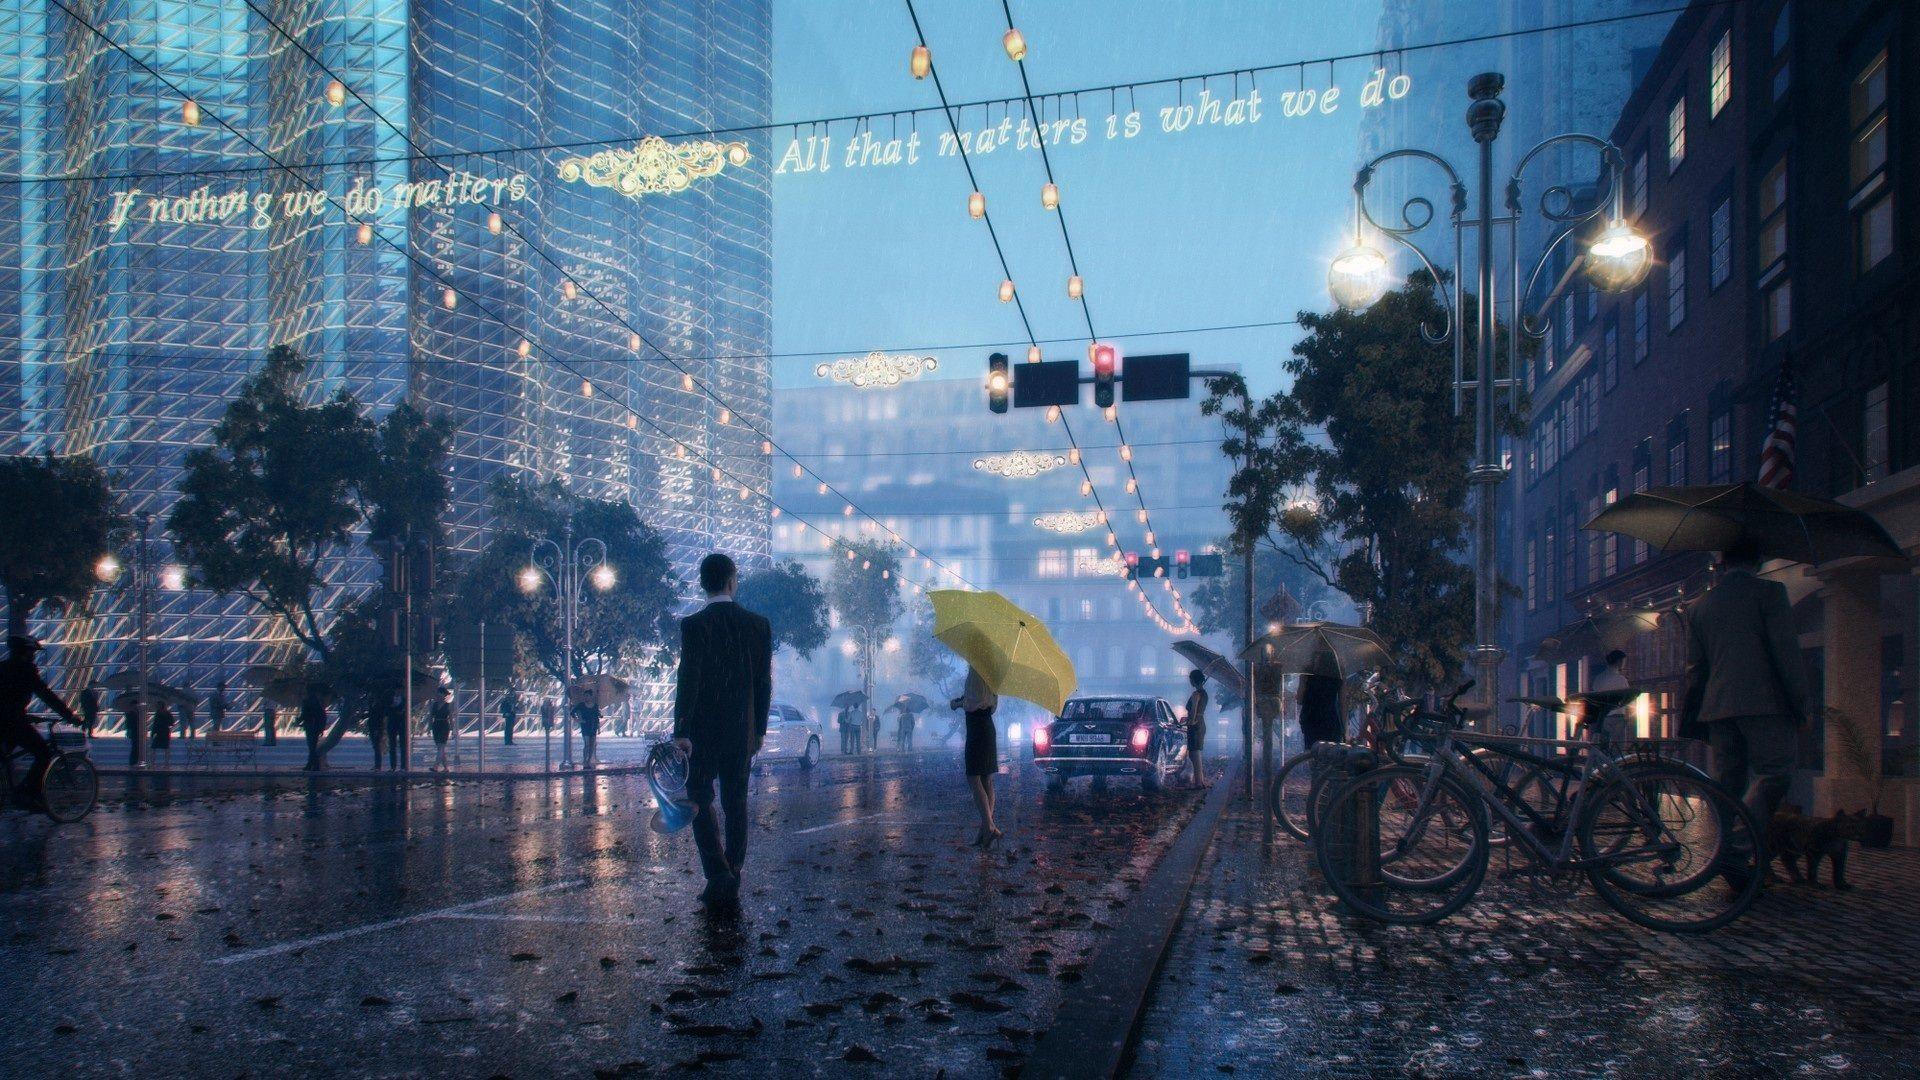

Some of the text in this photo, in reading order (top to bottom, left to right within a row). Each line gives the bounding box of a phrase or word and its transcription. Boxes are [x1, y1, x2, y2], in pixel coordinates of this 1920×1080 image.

[775, 68, 1412, 174] All that matters is what we do
[109, 189, 141, 233] If
[282, 187, 328, 217] we
[345, 176, 383, 216] do
[394, 172, 526, 206] matters
